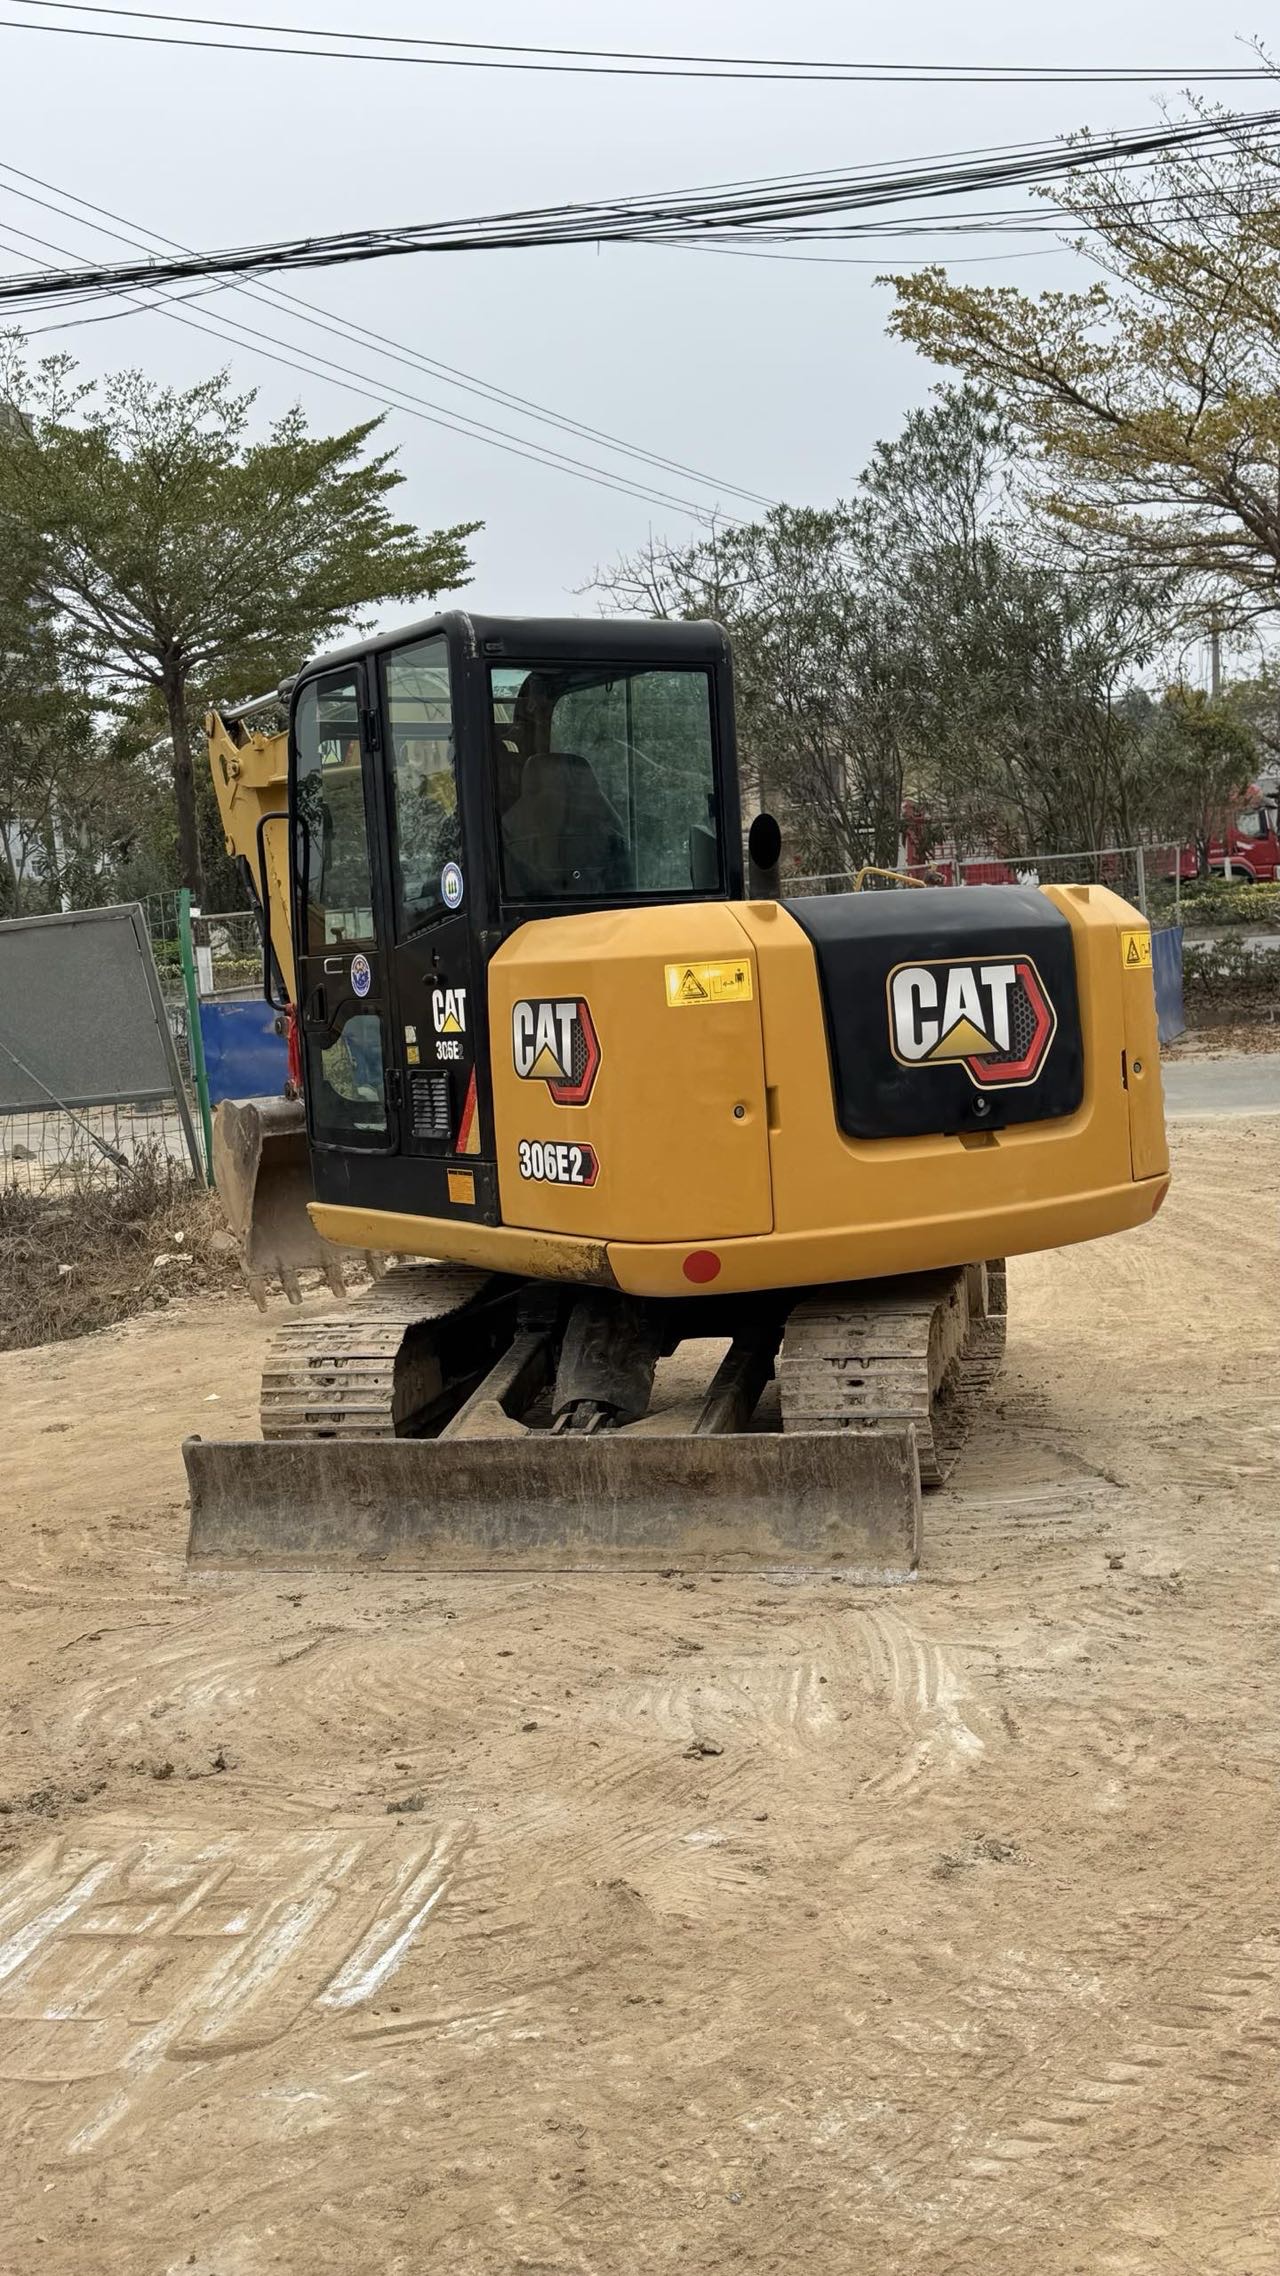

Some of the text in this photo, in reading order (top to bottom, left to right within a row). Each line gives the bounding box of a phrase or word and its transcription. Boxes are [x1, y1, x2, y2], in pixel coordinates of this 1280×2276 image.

[432, 988, 466, 1033] CAT
[513, 1002, 577, 1077] CAT
[893, 964, 1016, 1059] CAT
[519, 1141, 584, 1183] 306E2
